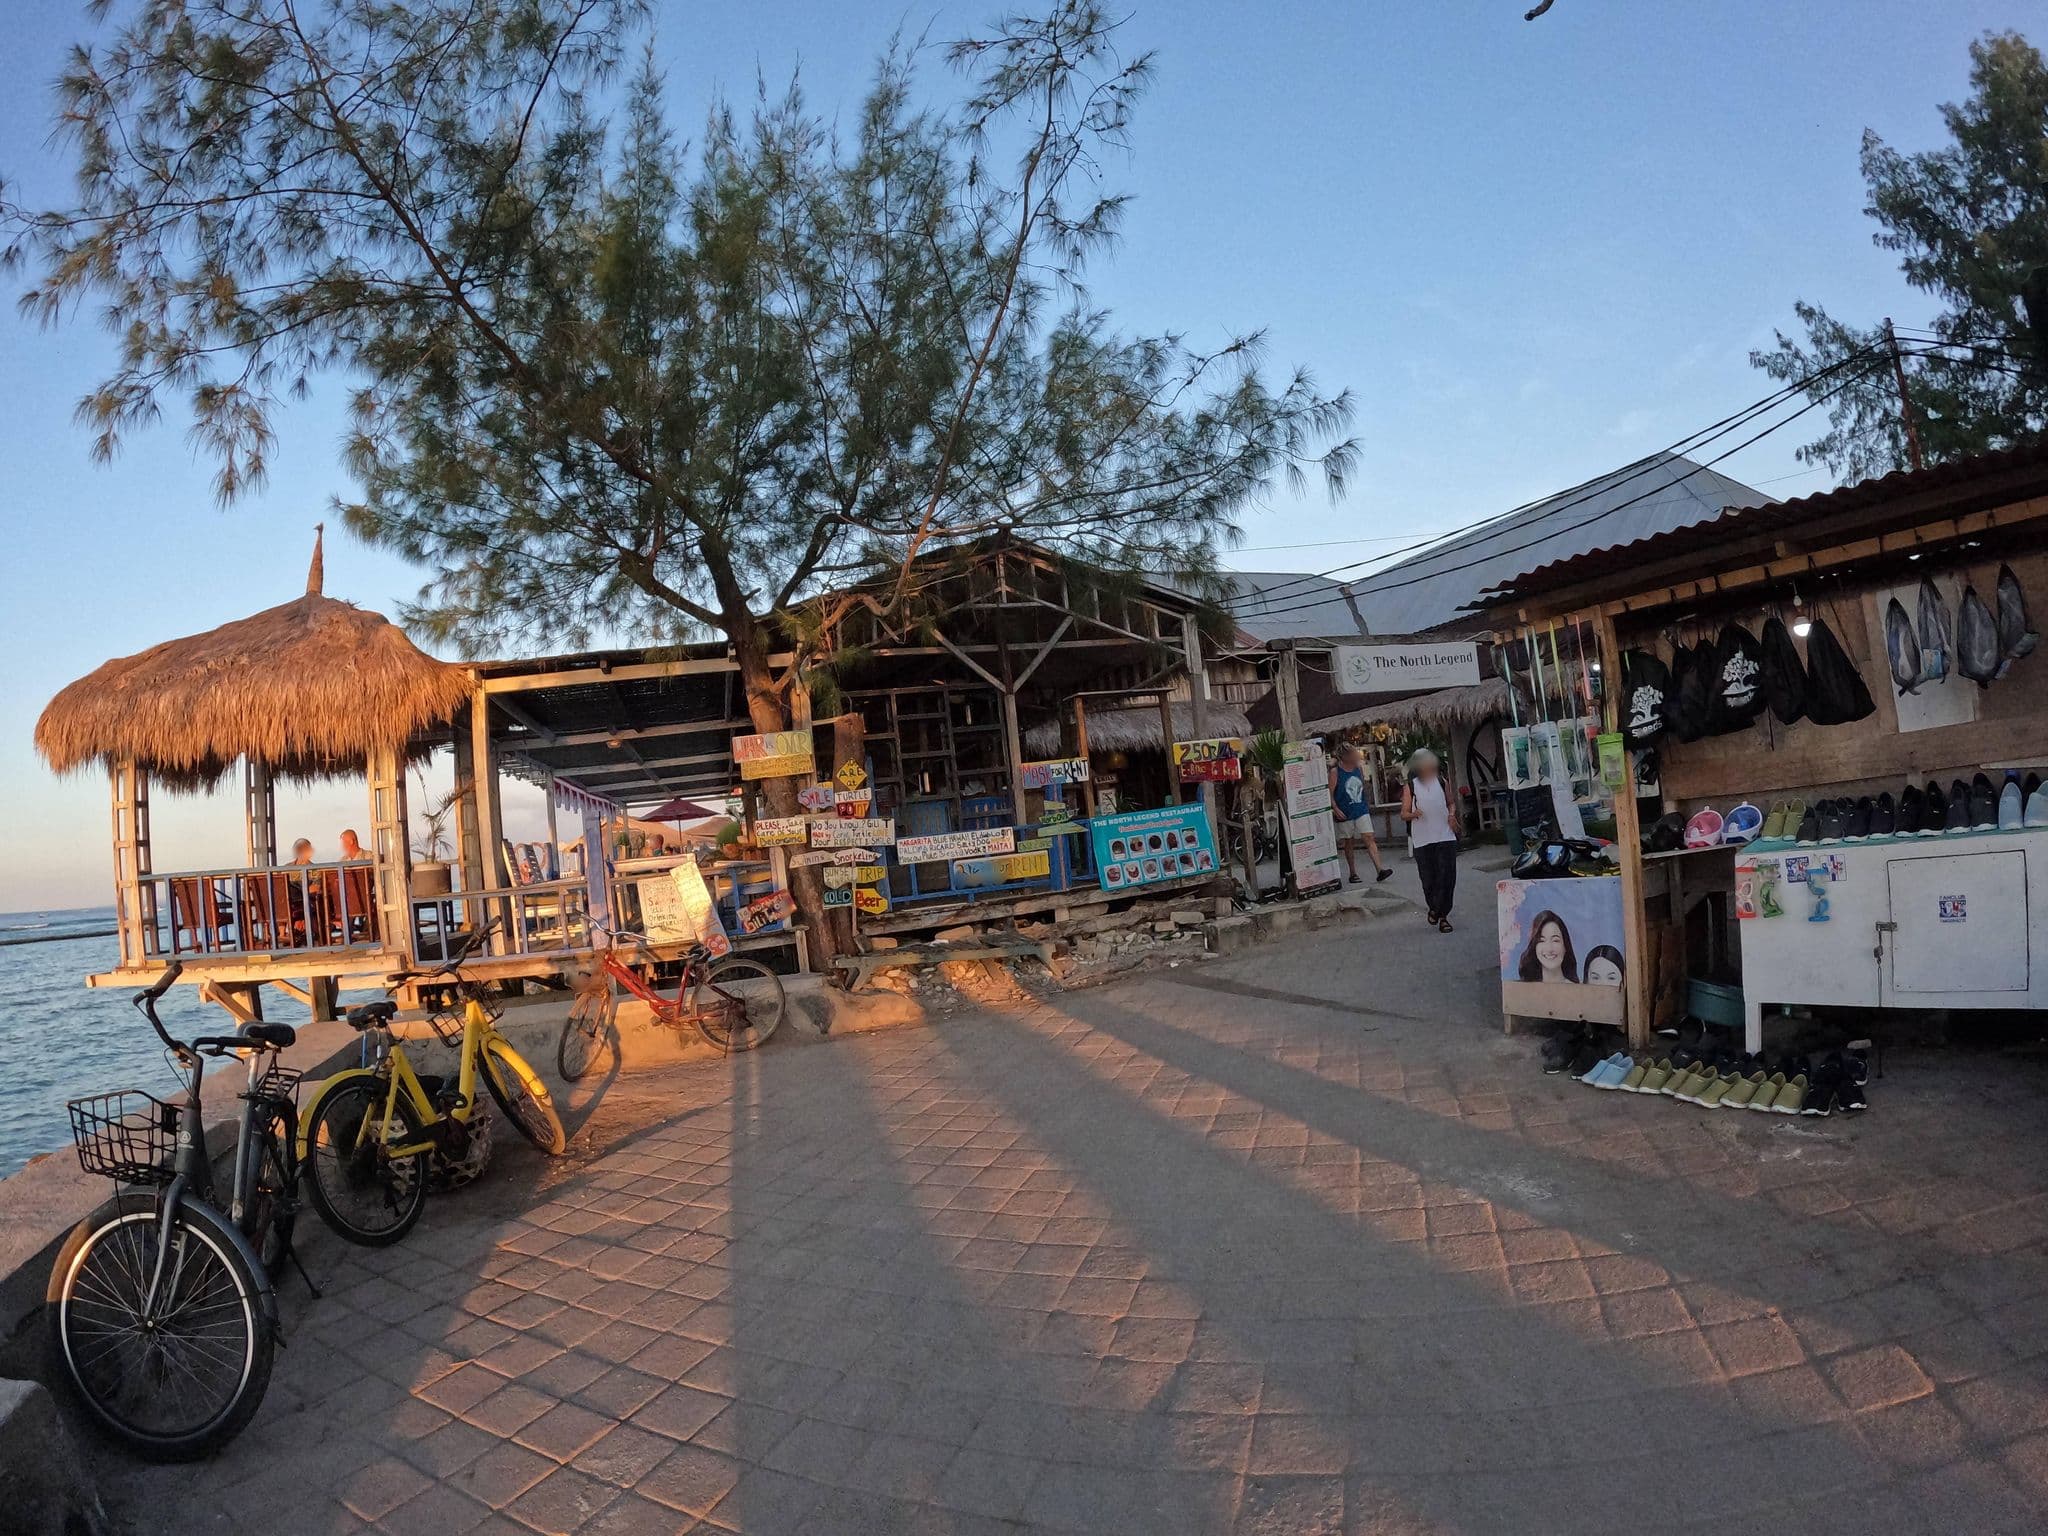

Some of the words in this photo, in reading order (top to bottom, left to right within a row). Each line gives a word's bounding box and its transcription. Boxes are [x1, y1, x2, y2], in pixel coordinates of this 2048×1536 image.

[1373, 656, 1397, 669] The
[1400, 655, 1431, 668] North
[1434, 652, 1473, 666] Legend
[839, 767, 863, 777] ARE
[1052, 767, 1063, 776] FOR
[1064, 759, 1088, 783] RENT
[837, 790, 869, 802] TURTLE
[1109, 816, 1133, 825] NORTH
[1133, 812, 1160, 821] LEGEND
[1161, 806, 1203, 817] RESTAURANT
[900, 837, 932, 846] MARGARITA
[933, 836, 948, 844] BLUE
[929, 843, 955, 851] RICARD
[1011, 855, 1046, 876] RENT
[857, 867, 885, 881] TRIP
[824, 890, 852, 904] COLD
[855, 890, 882, 908] Beer
